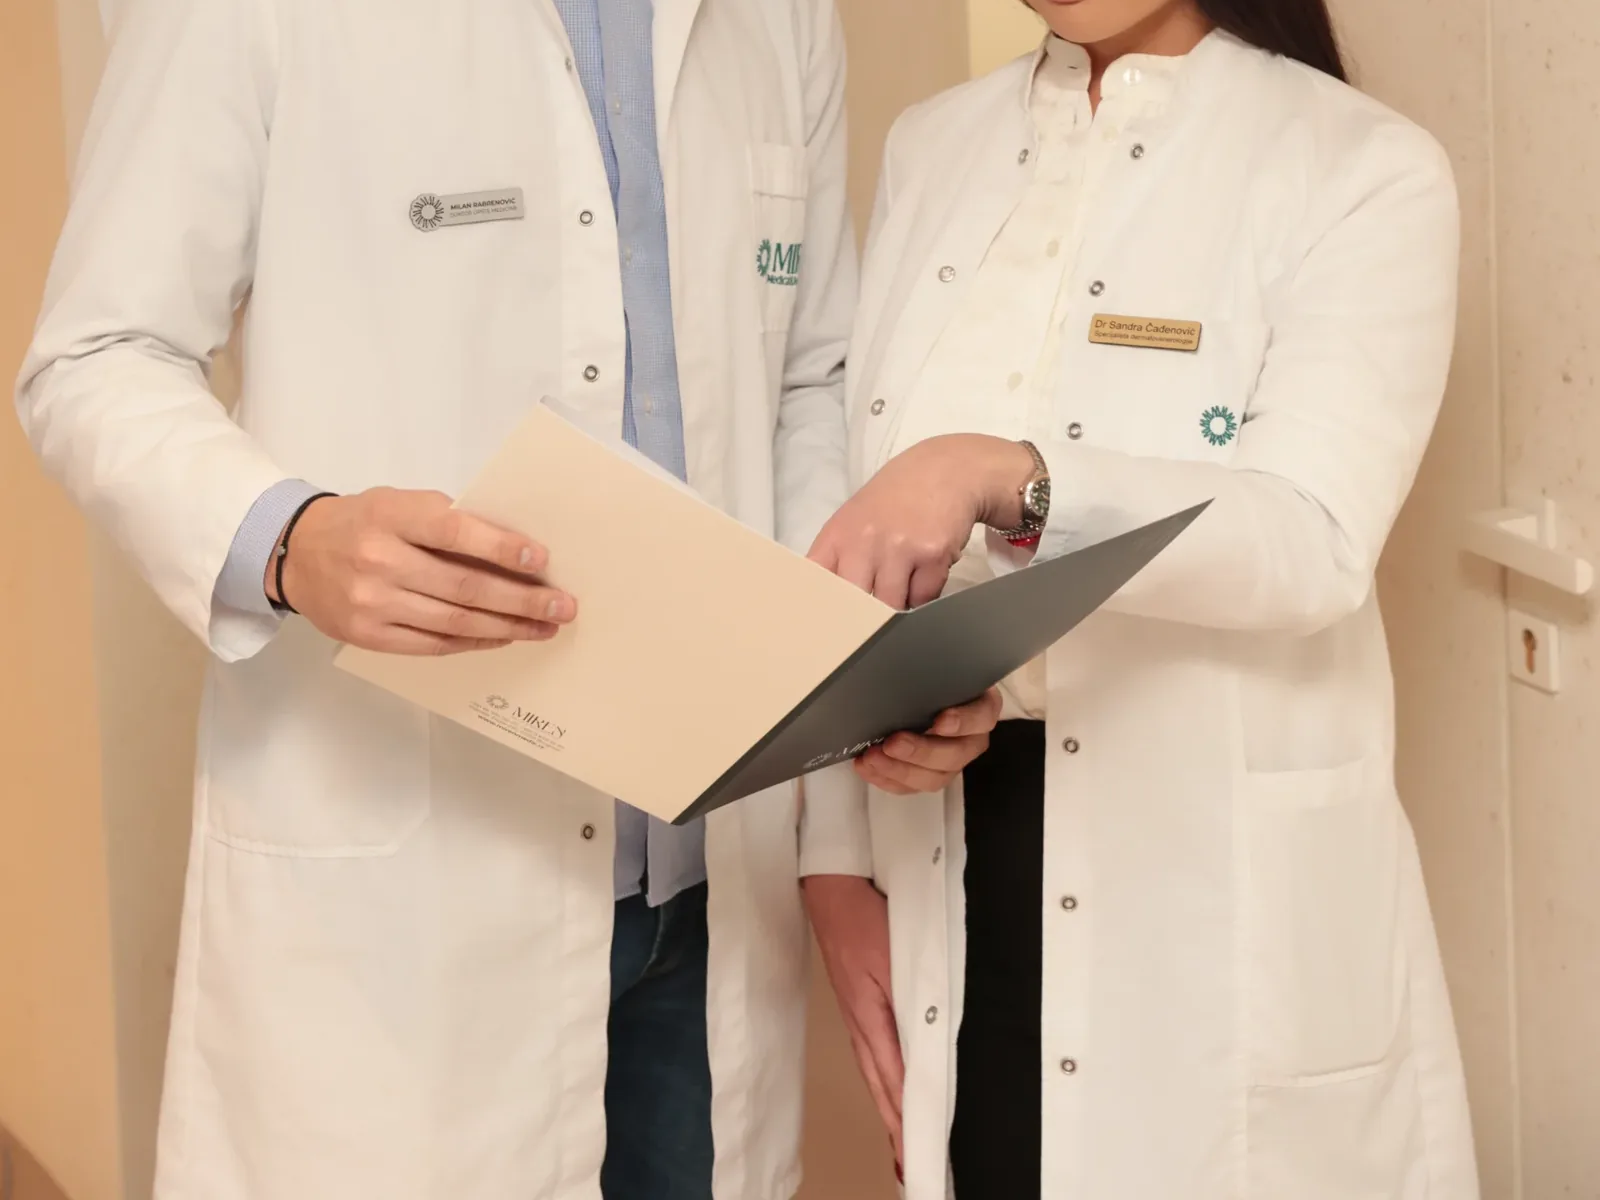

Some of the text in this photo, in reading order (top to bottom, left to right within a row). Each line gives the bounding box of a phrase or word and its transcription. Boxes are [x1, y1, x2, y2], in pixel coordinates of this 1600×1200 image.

[450, 202, 472, 210] MILAN
[1094, 319, 1106, 328] Dr
[1109, 320, 1143, 332] Sandra
